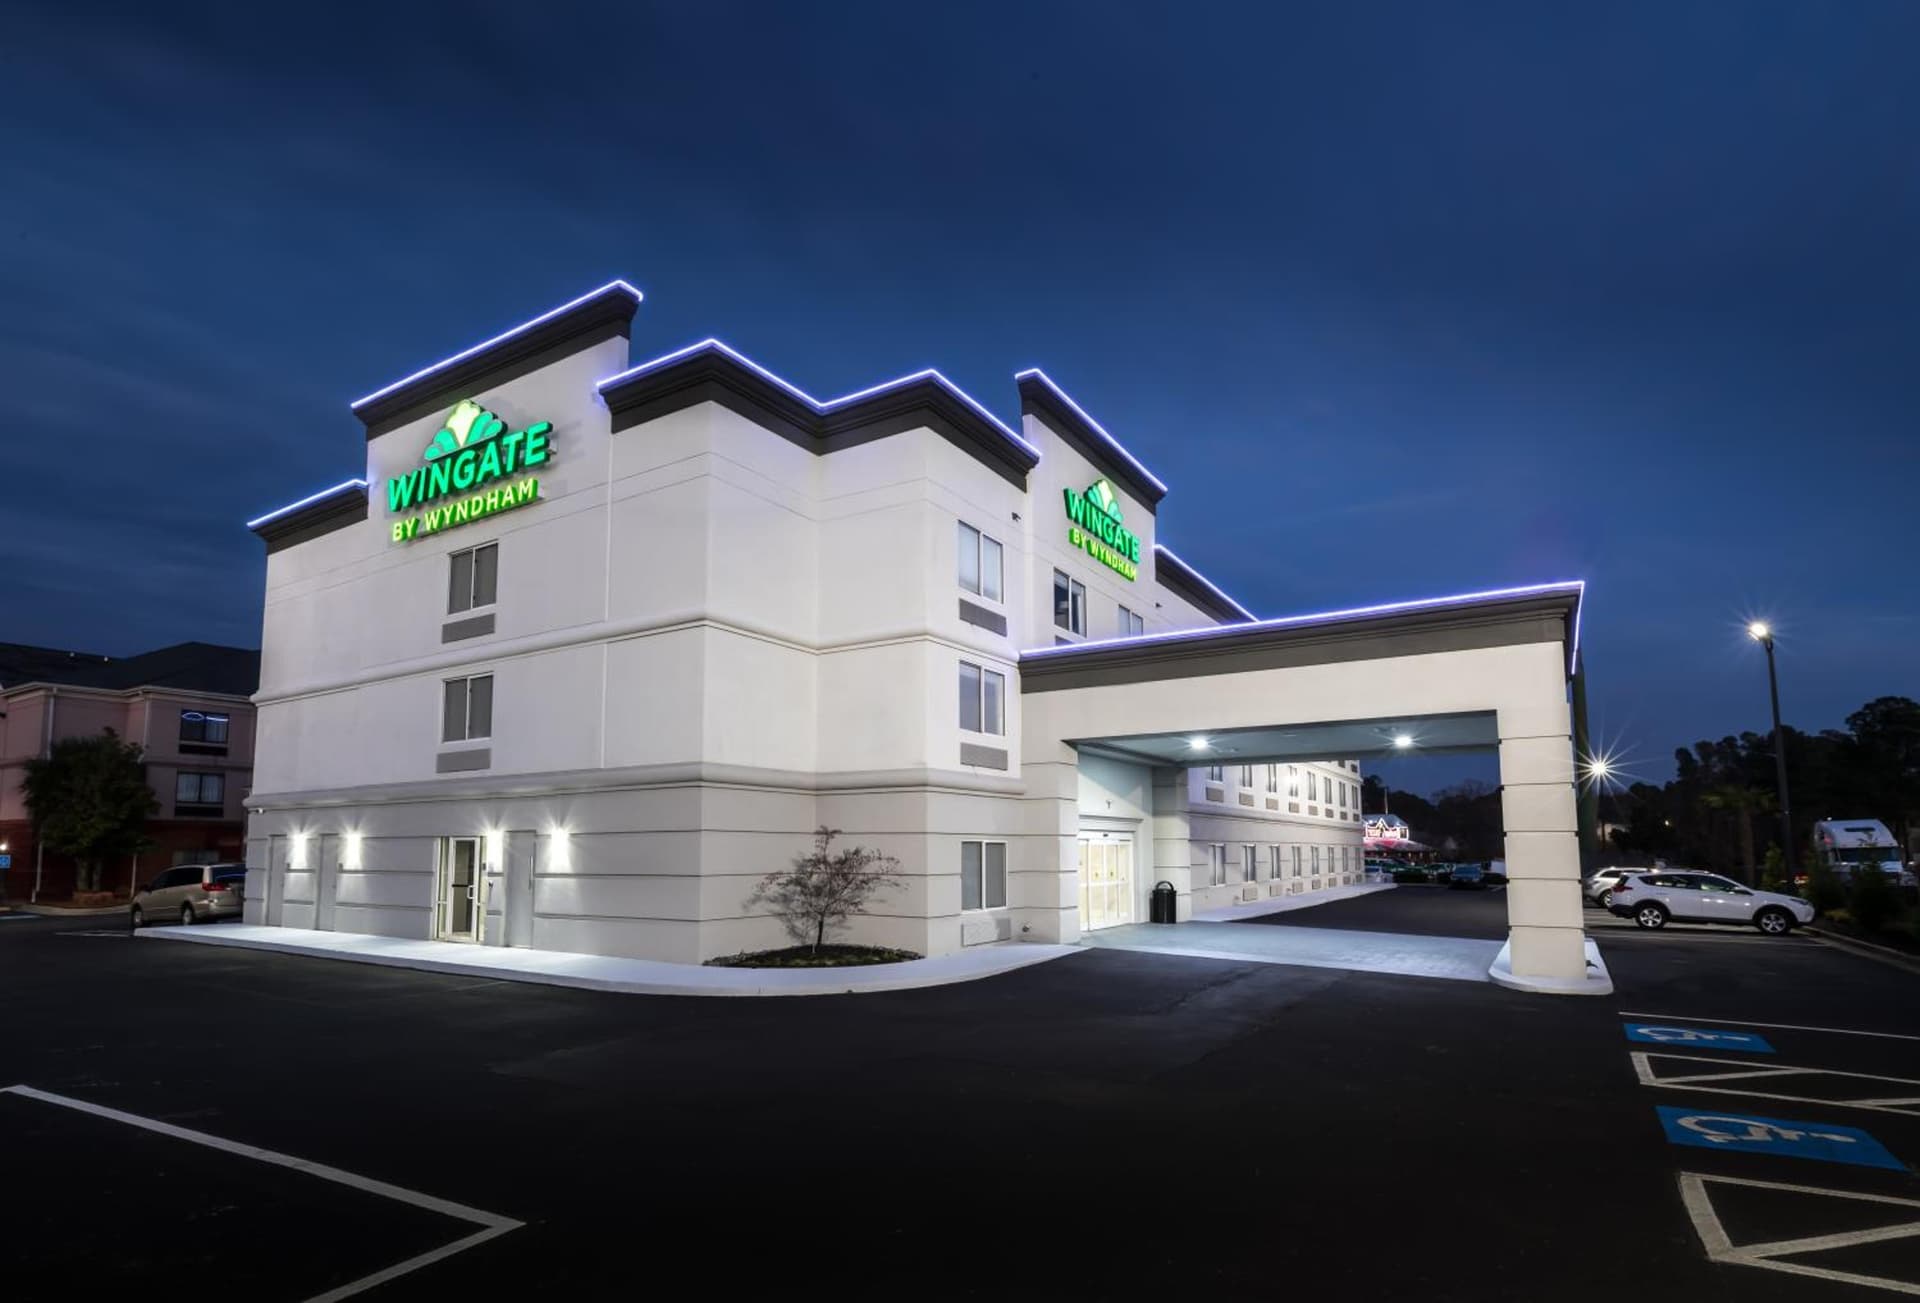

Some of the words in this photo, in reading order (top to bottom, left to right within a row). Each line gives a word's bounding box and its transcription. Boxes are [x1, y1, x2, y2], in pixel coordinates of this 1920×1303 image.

[387, 421, 552, 512] WINGATE
[392, 517, 419, 541] BY
[424, 477, 538, 531] WYNDHAM
[1064, 488, 1139, 564] WINGATE
[1069, 528, 1086, 548] BY
[1087, 540, 1137, 581] WYNDHAM
